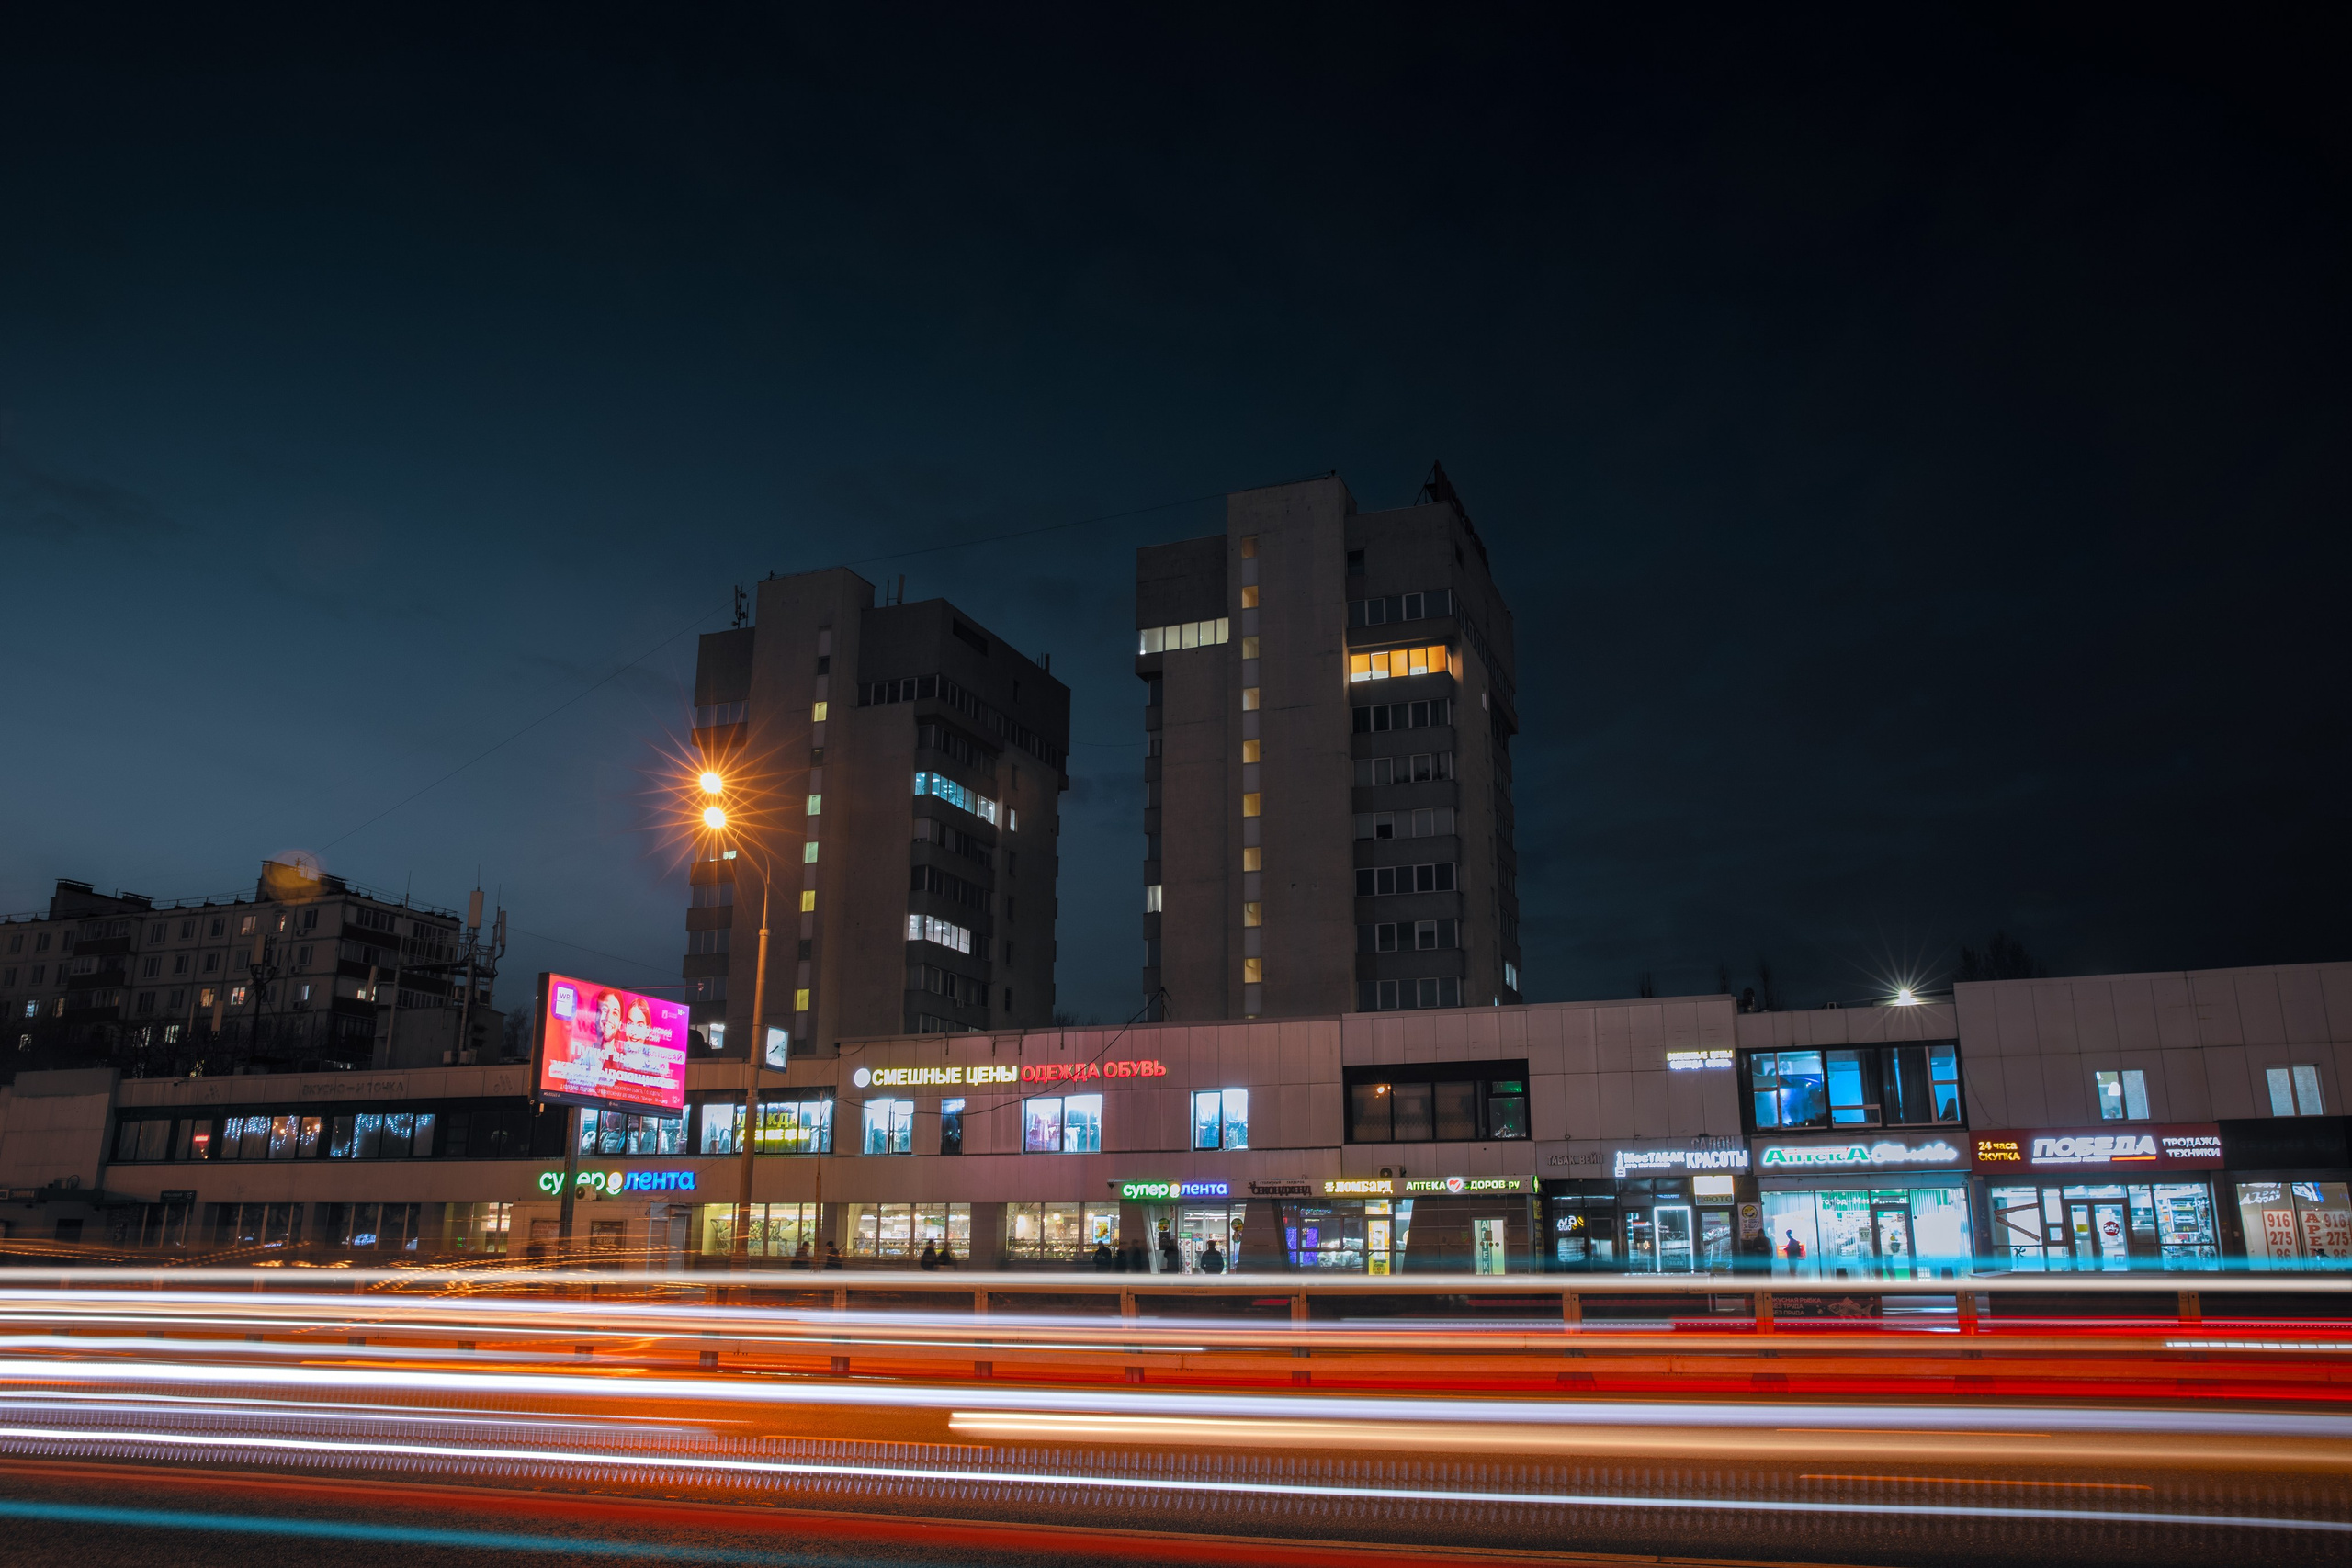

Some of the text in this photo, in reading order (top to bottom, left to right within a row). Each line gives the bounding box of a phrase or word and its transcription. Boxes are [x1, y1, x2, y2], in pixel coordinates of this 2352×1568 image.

[872, 1065, 1018, 1087] СМЕШНЫЕ ЦЕНЫ
[1021, 1060, 1167, 1085] ОДЕЖДА ОБУВЬ
[1690, 1135, 1736, 1150] САЛОН
[1978, 1141, 2018, 1150] 24 часа
[2033, 1136, 2156, 1157] ПОБЕДА
[2162, 1136, 2222, 1147] ПРОДАЖА
[1547, 1152, 1604, 1166] ТАБАК ВЕЙП
[1685, 1149, 1748, 1169] КРАСОТЫ
[1978, 1151, 2021, 1161] СКУПКА
[2165, 1147, 2221, 1158] ТЕХНИКИ
[539, 1171, 695, 1195] суер лента
[1123, 1182, 1228, 1199] супер лента
[1406, 1181, 1446, 1190] АПТЕКА
[1703, 1195, 1733, 1203] ФОТО
[2267, 1213, 2290, 1228] 916
[2324, 1213, 2346, 1228] 916
[2269, 1231, 2293, 1246] 275
[2326, 1232, 2349, 1246] 275
